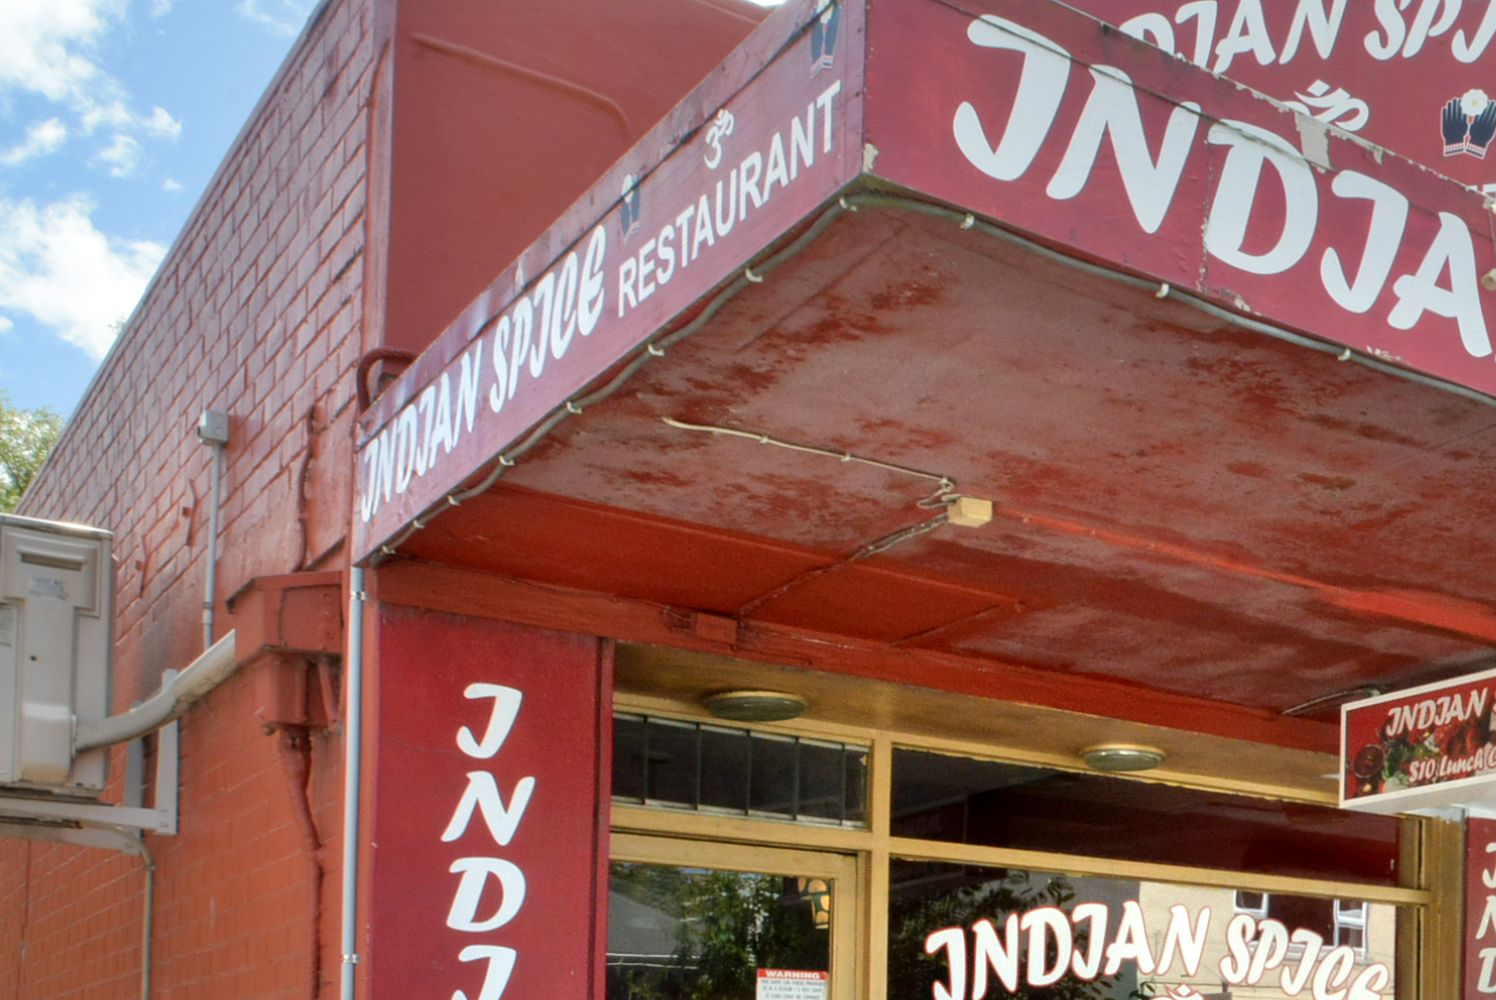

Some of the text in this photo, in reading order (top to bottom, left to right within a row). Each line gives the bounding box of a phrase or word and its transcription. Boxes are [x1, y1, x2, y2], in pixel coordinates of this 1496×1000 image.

[618, 80, 840, 317] RESTAURANT
[359, 223, 605, 523] INDIAN SPICE
[1408, 759, 1437, 784] $10
[1439, 751, 1485, 775] Lunch
[766, 970, 820, 980] WARNING
